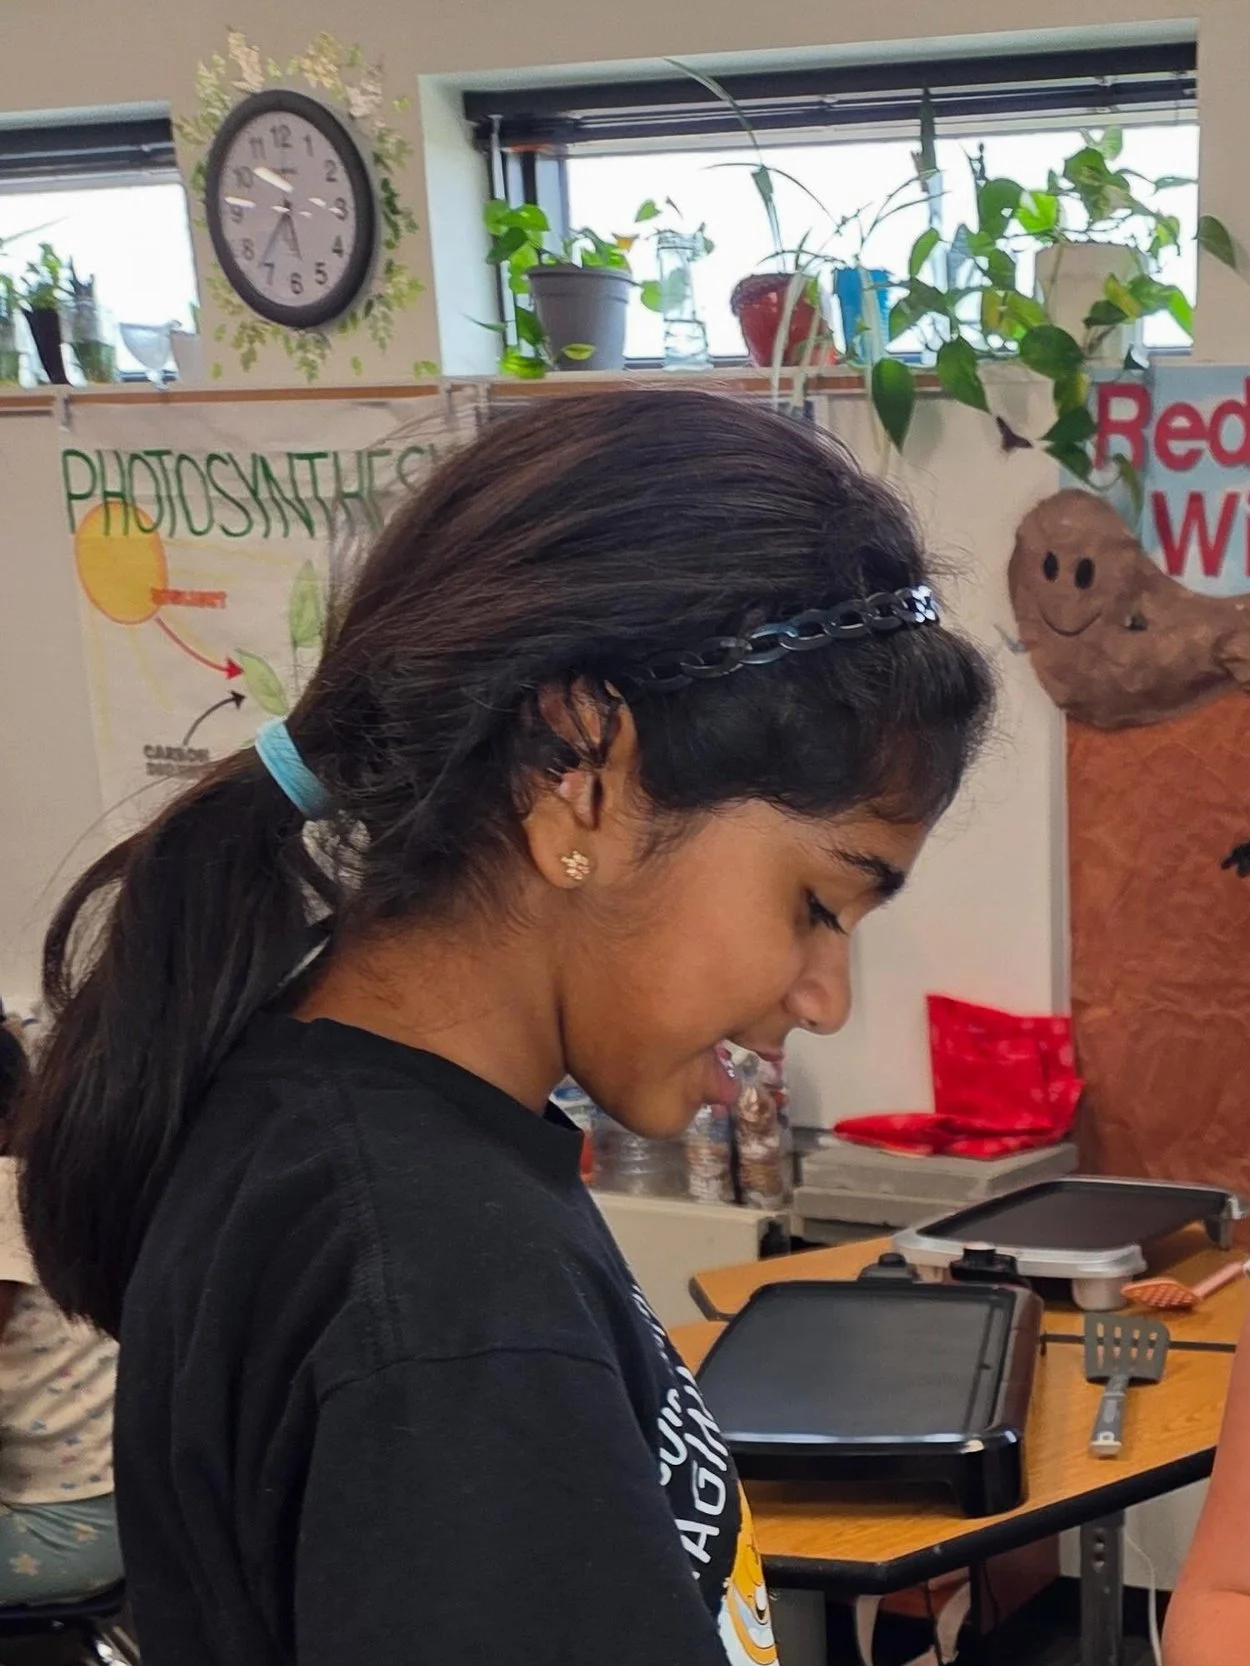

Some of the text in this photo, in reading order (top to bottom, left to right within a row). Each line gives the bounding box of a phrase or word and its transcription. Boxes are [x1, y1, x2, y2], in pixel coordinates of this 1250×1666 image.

[270, 124, 292, 148] 12
[303, 134, 313, 157] 1
[250, 137, 266, 160] 11
[232, 165, 254, 188] 10
[325, 159, 338, 182] 2
[334, 197, 347, 221] 3
[241, 238, 254, 261] 8
[332, 236, 344, 257] 4
[263, 261, 275, 286] 7
[290, 272, 304, 295] 6
[315, 262, 328, 285] 5
